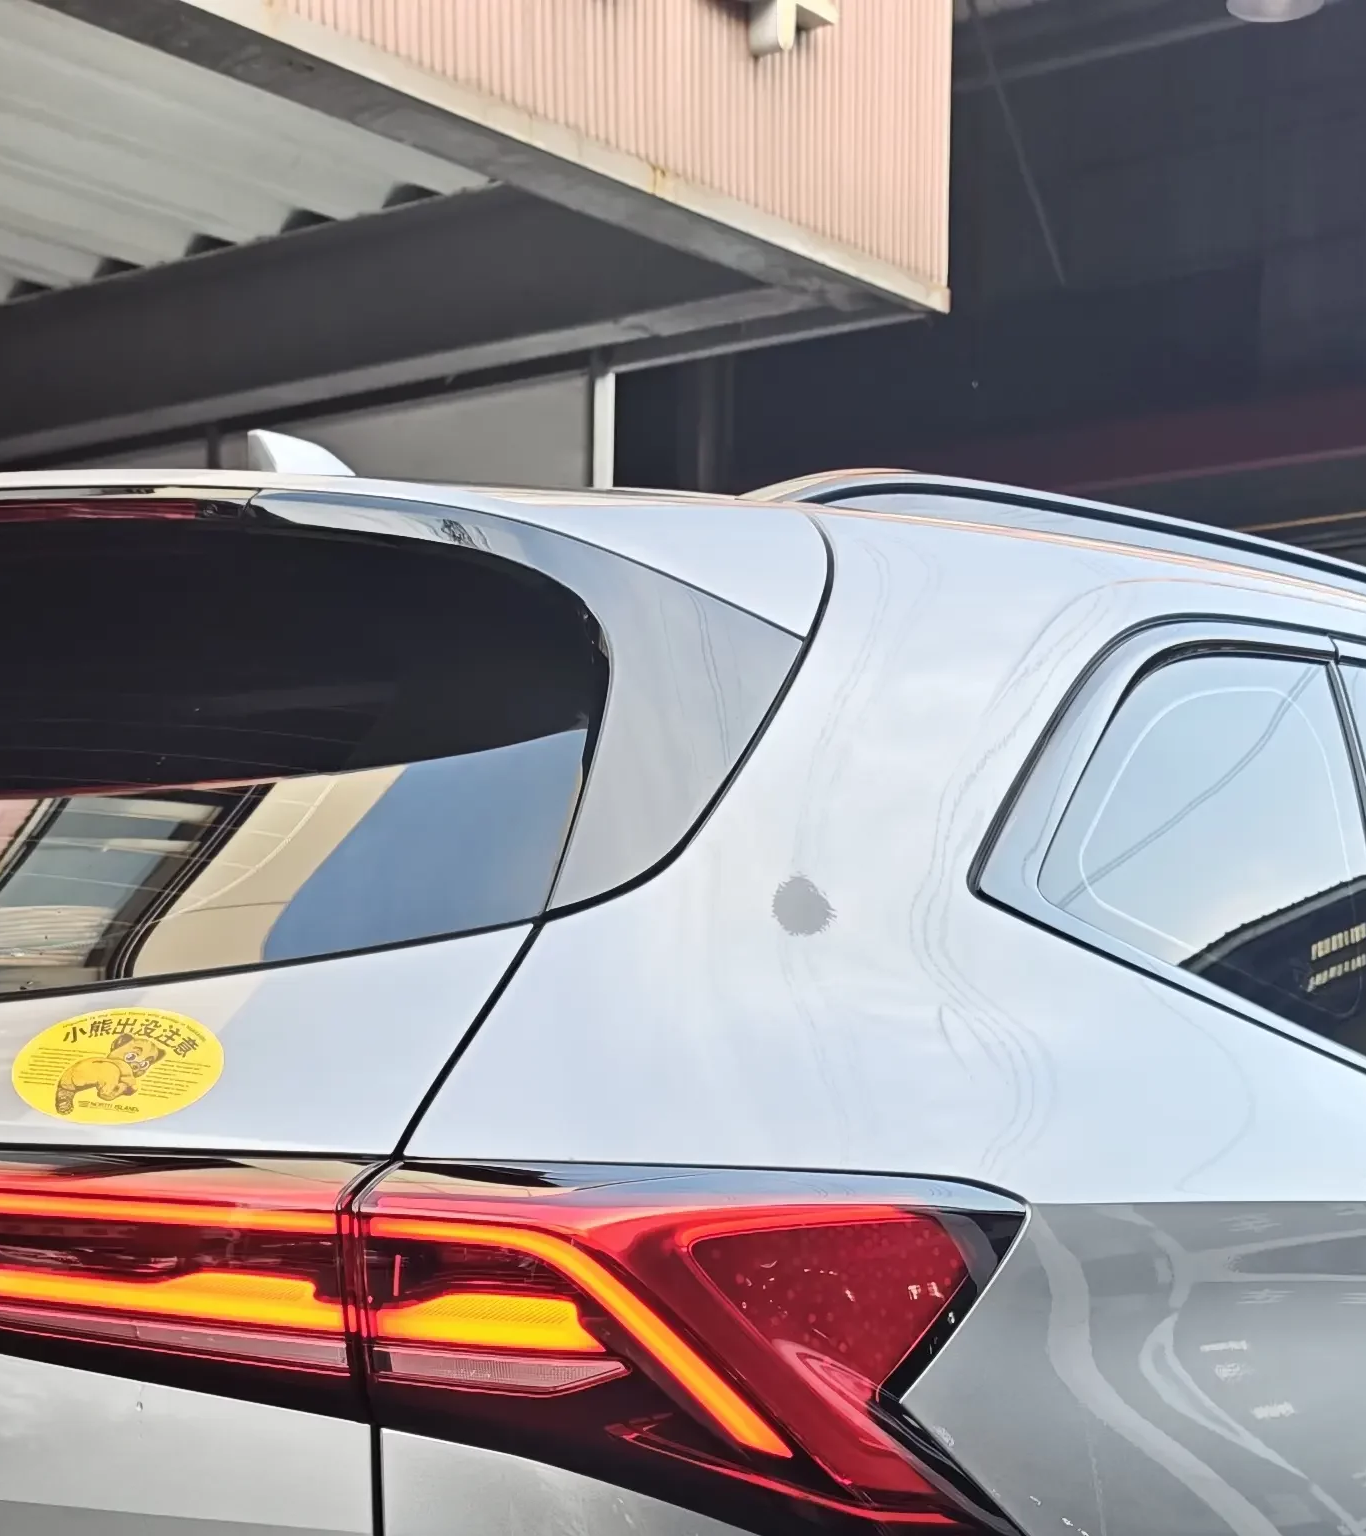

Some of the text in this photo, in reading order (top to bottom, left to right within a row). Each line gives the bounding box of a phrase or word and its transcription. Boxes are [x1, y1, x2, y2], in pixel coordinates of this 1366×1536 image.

[62, 1017, 200, 1058] 小熊出没注意
